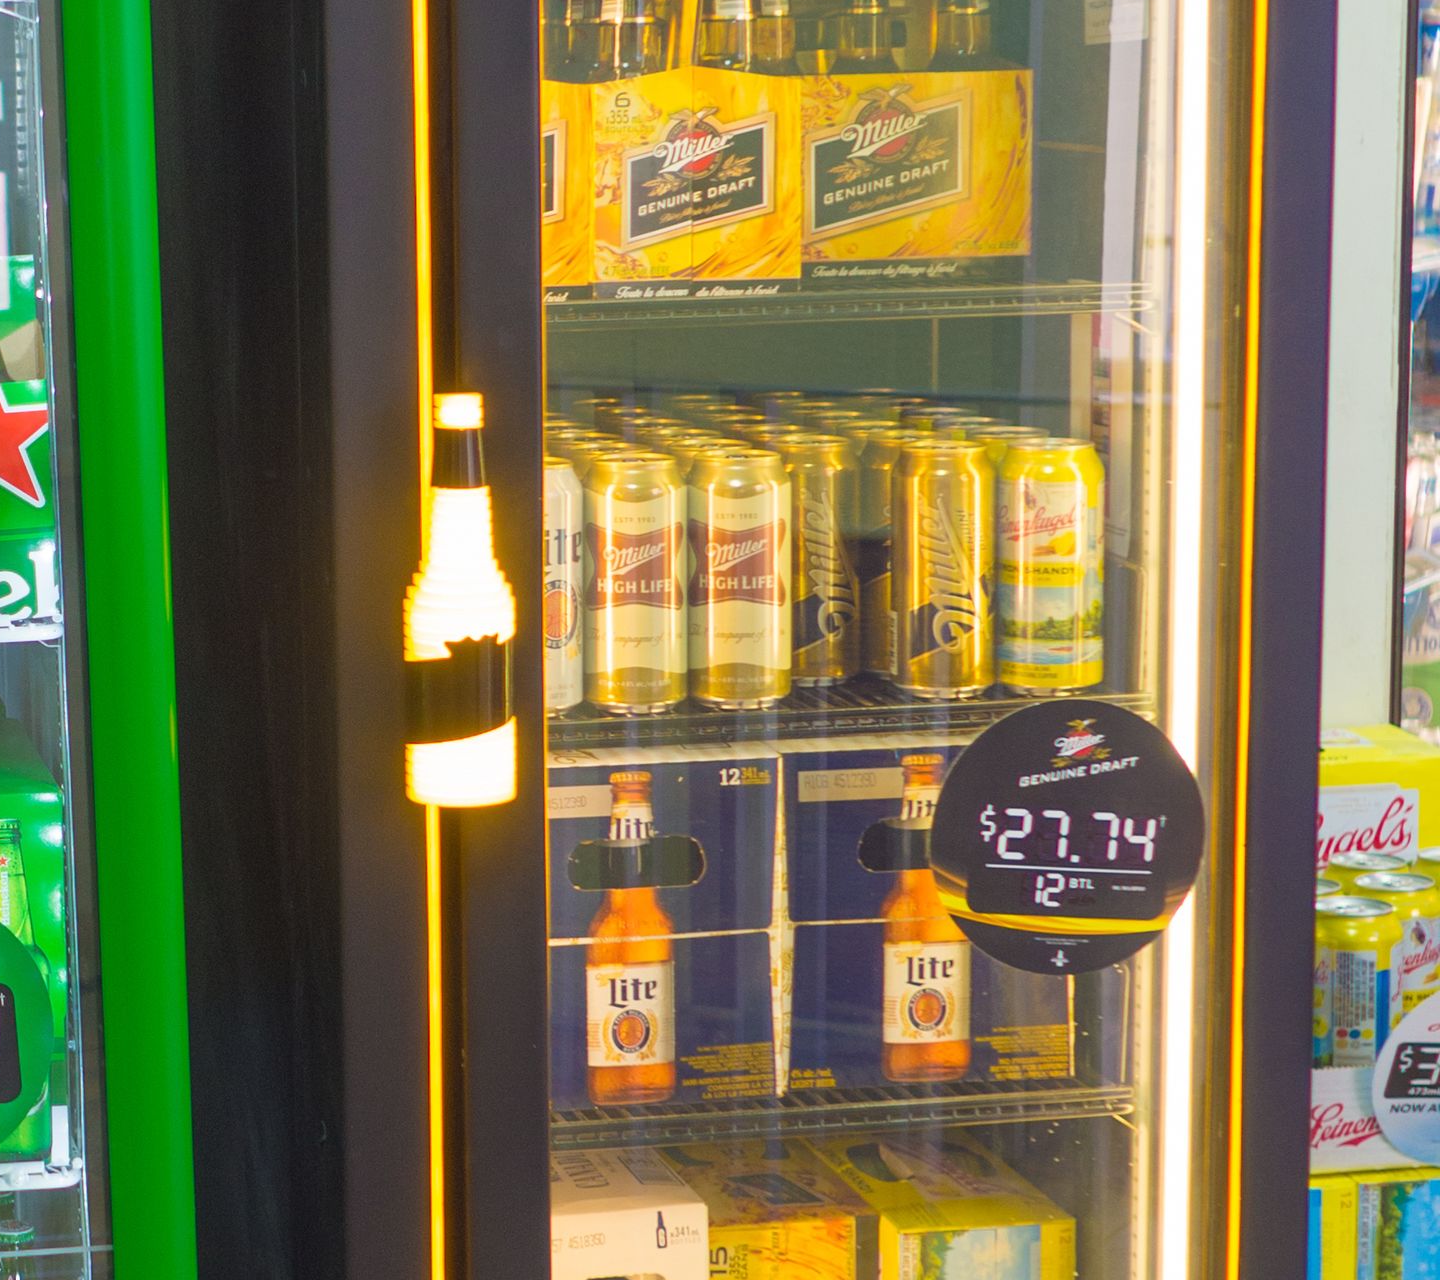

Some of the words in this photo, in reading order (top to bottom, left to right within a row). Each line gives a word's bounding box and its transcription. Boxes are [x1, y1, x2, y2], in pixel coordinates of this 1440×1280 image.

[615, 92, 631, 108] 6
[841, 112, 929, 159] Miller
[653, 133, 735, 174] Miller
[638, 190, 702, 216] GENUINE
[708, 176, 756, 198] DRAFT
[823, 175, 894, 205] GENUINE
[899, 159, 950, 184] DRAFT
[603, 542, 667, 576] Miller
[705, 538, 768, 572] Miller
[597, 578, 637, 594] HIGH
[641, 578, 673, 593] LIFE
[699, 574, 737, 590] HIGH
[742, 575, 774, 590] LIFE
[1054, 733, 1105, 756] Miller
[719, 768, 740, 786] 12
[1019, 766, 1086, 787] GENUINE
[1089, 756, 1139, 774] DRAFT
[980, 804, 1157, 863] $27.74
[1035, 873, 1064, 907] 12
[1069, 878, 1095, 890] BTL
[906, 956, 954, 986] Lite
[608, 978, 657, 1008] Lite
[1390, 1104, 1426, 1113] NOW
[710, 1246, 727, 1278] 15
